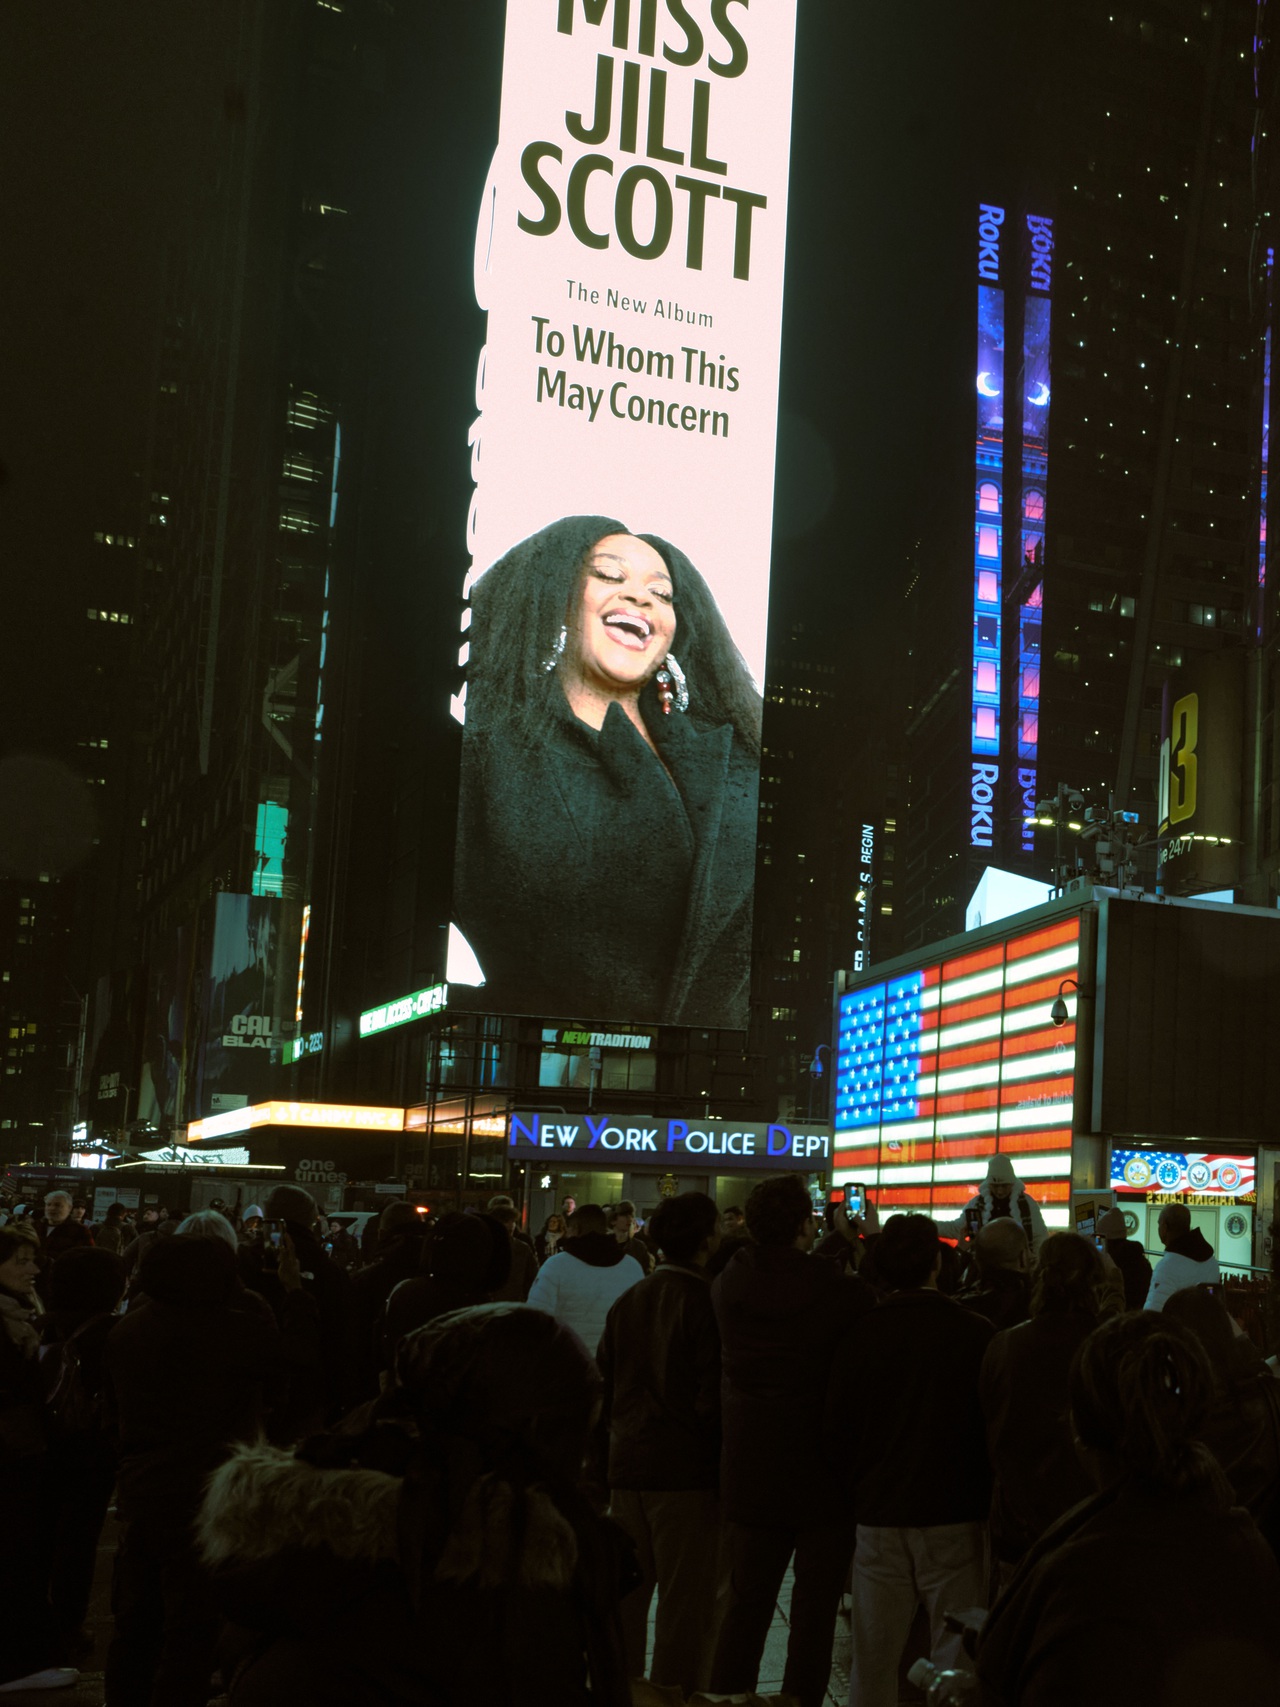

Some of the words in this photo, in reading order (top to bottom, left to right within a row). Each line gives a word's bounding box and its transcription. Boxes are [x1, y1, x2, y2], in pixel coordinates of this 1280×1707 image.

[565, 53, 728, 176] JILL
[516, 139, 768, 282] SCOTT
[566, 279, 600, 305] The
[606, 288, 647, 315] New
[654, 298, 714, 328] Album
[531, 315, 565, 357] To
[572, 324, 675, 380] Whom
[681, 346, 740, 392] This
[536, 366, 604, 423] May
[609, 381, 730, 438] Concern
[861, 824, 874, 864] BEGIN
[301, 1107, 353, 1123] CANDY
[356, 1110, 386, 1125] NYC
[295, 1169, 348, 1183] times
[299, 1158, 336, 1172] one
